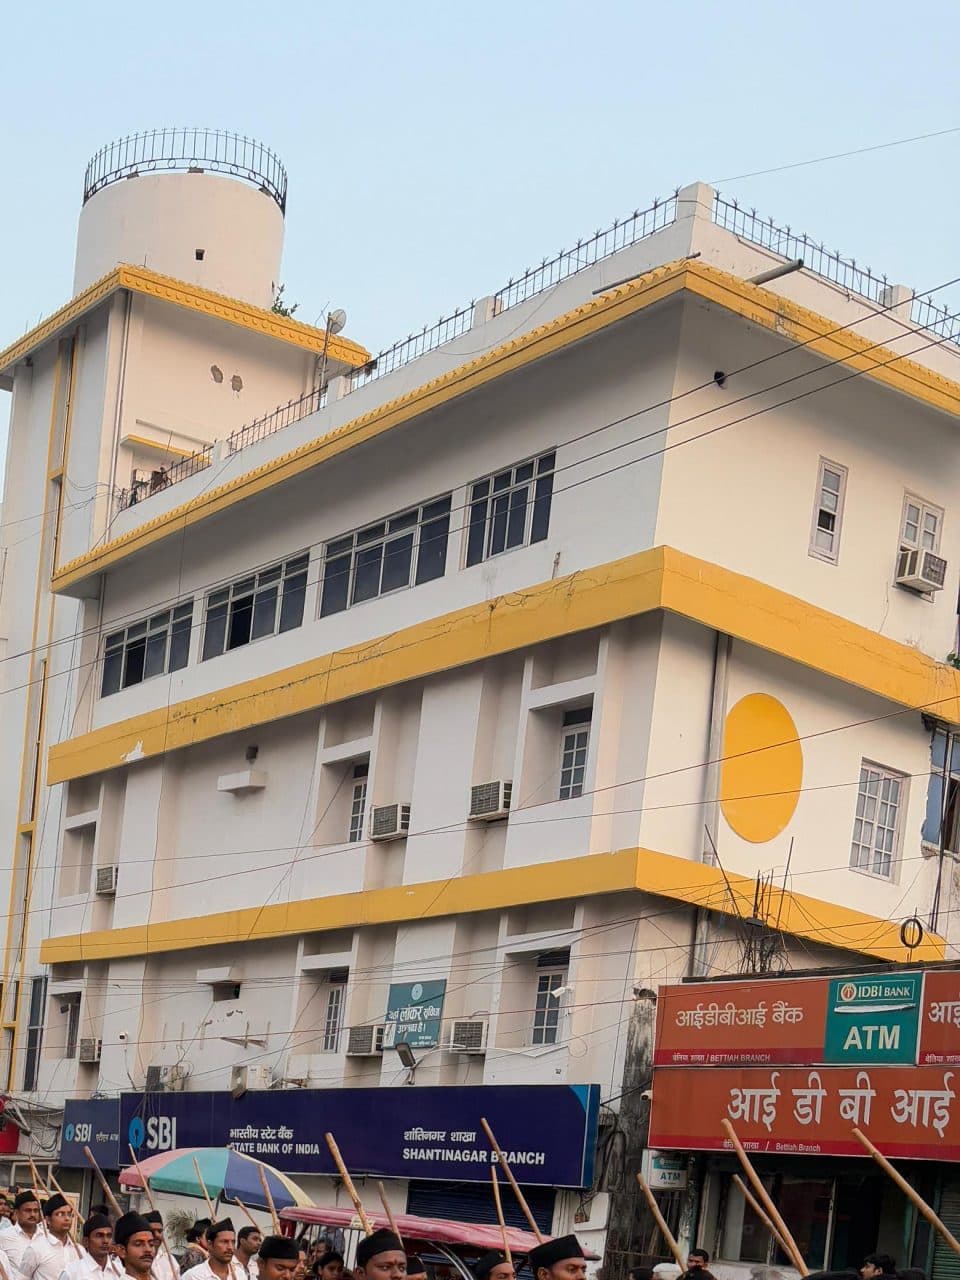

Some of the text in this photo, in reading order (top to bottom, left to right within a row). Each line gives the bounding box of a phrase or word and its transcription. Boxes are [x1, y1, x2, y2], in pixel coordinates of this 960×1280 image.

[858, 983, 911, 999] IDBI BANK
[675, 1001, 804, 1029] आईडीबीआई बैंक
[843, 1025, 901, 1050] ATM
[710, 1054, 771, 1062] BETTIAH BRANCH
[727, 1071, 956, 1138] आई डी बी आई
[75, 1123, 92, 1142] SBI
[146, 1116, 177, 1150] SBI
[229, 1125, 259, 1139] भारतीय
[261, 1126, 276, 1139] स्टेट
[450, 1131, 476, 1142] शाखा
[256, 1143, 280, 1153] BANK
[282, 1143, 293, 1154] OF
[295, 1144, 320, 1154] INDIA
[402, 1148, 488, 1163] SHANTINAGAR
[660, 1171, 681, 1181] ATM
